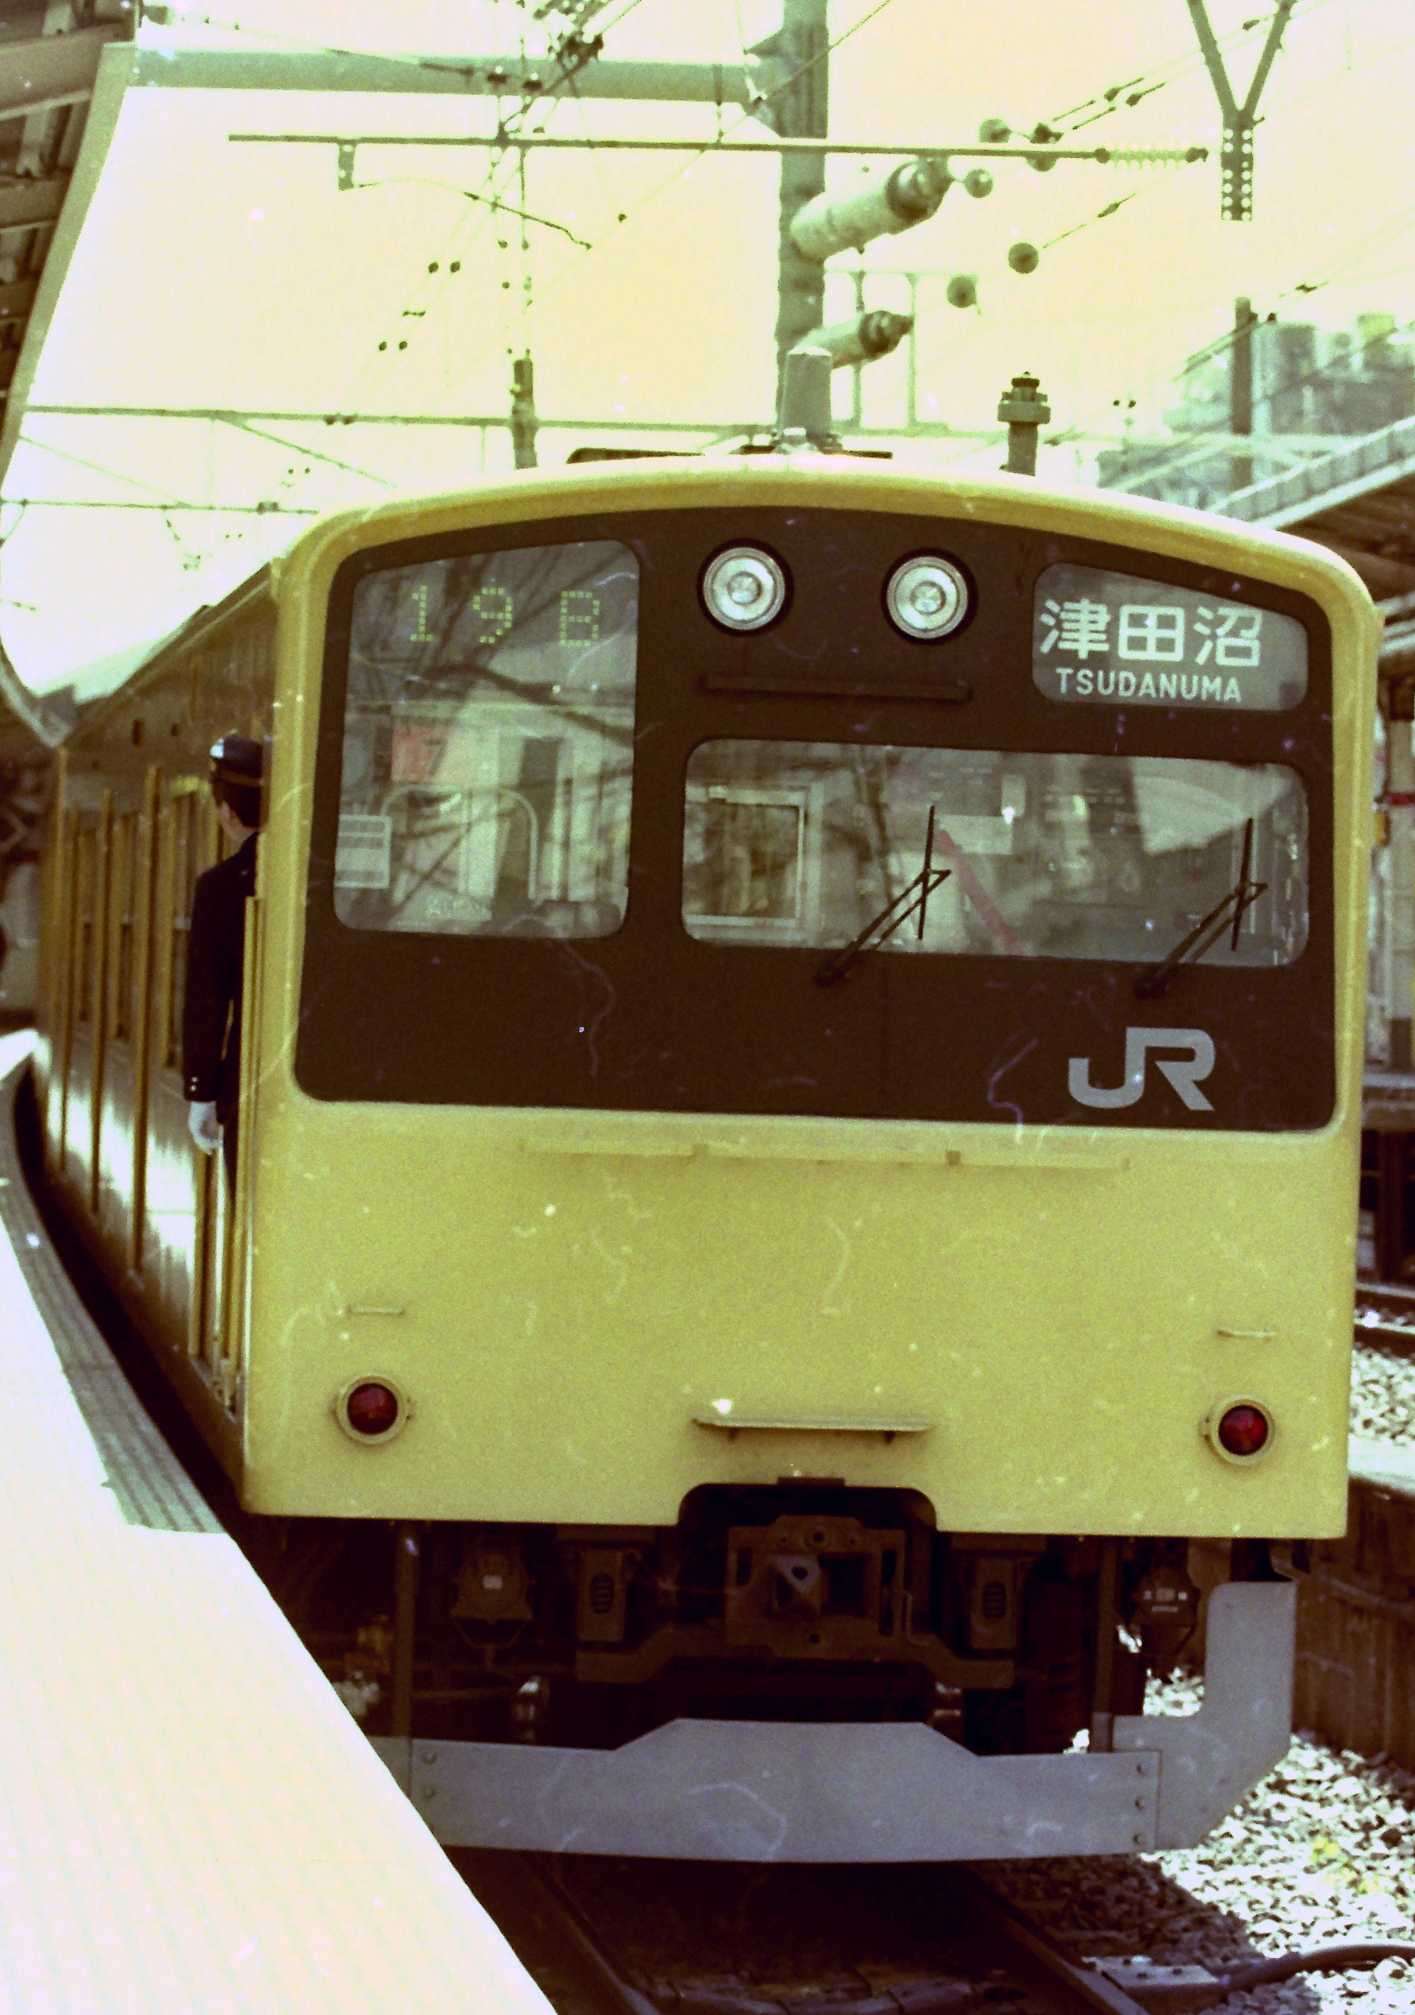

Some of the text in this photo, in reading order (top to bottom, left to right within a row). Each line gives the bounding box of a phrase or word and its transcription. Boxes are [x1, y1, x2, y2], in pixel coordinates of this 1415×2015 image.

[1040, 599, 1262, 667] 津田沼
[1056, 667, 1242, 703] TSUDANUMA
[1068, 1026, 1215, 1111] JR
